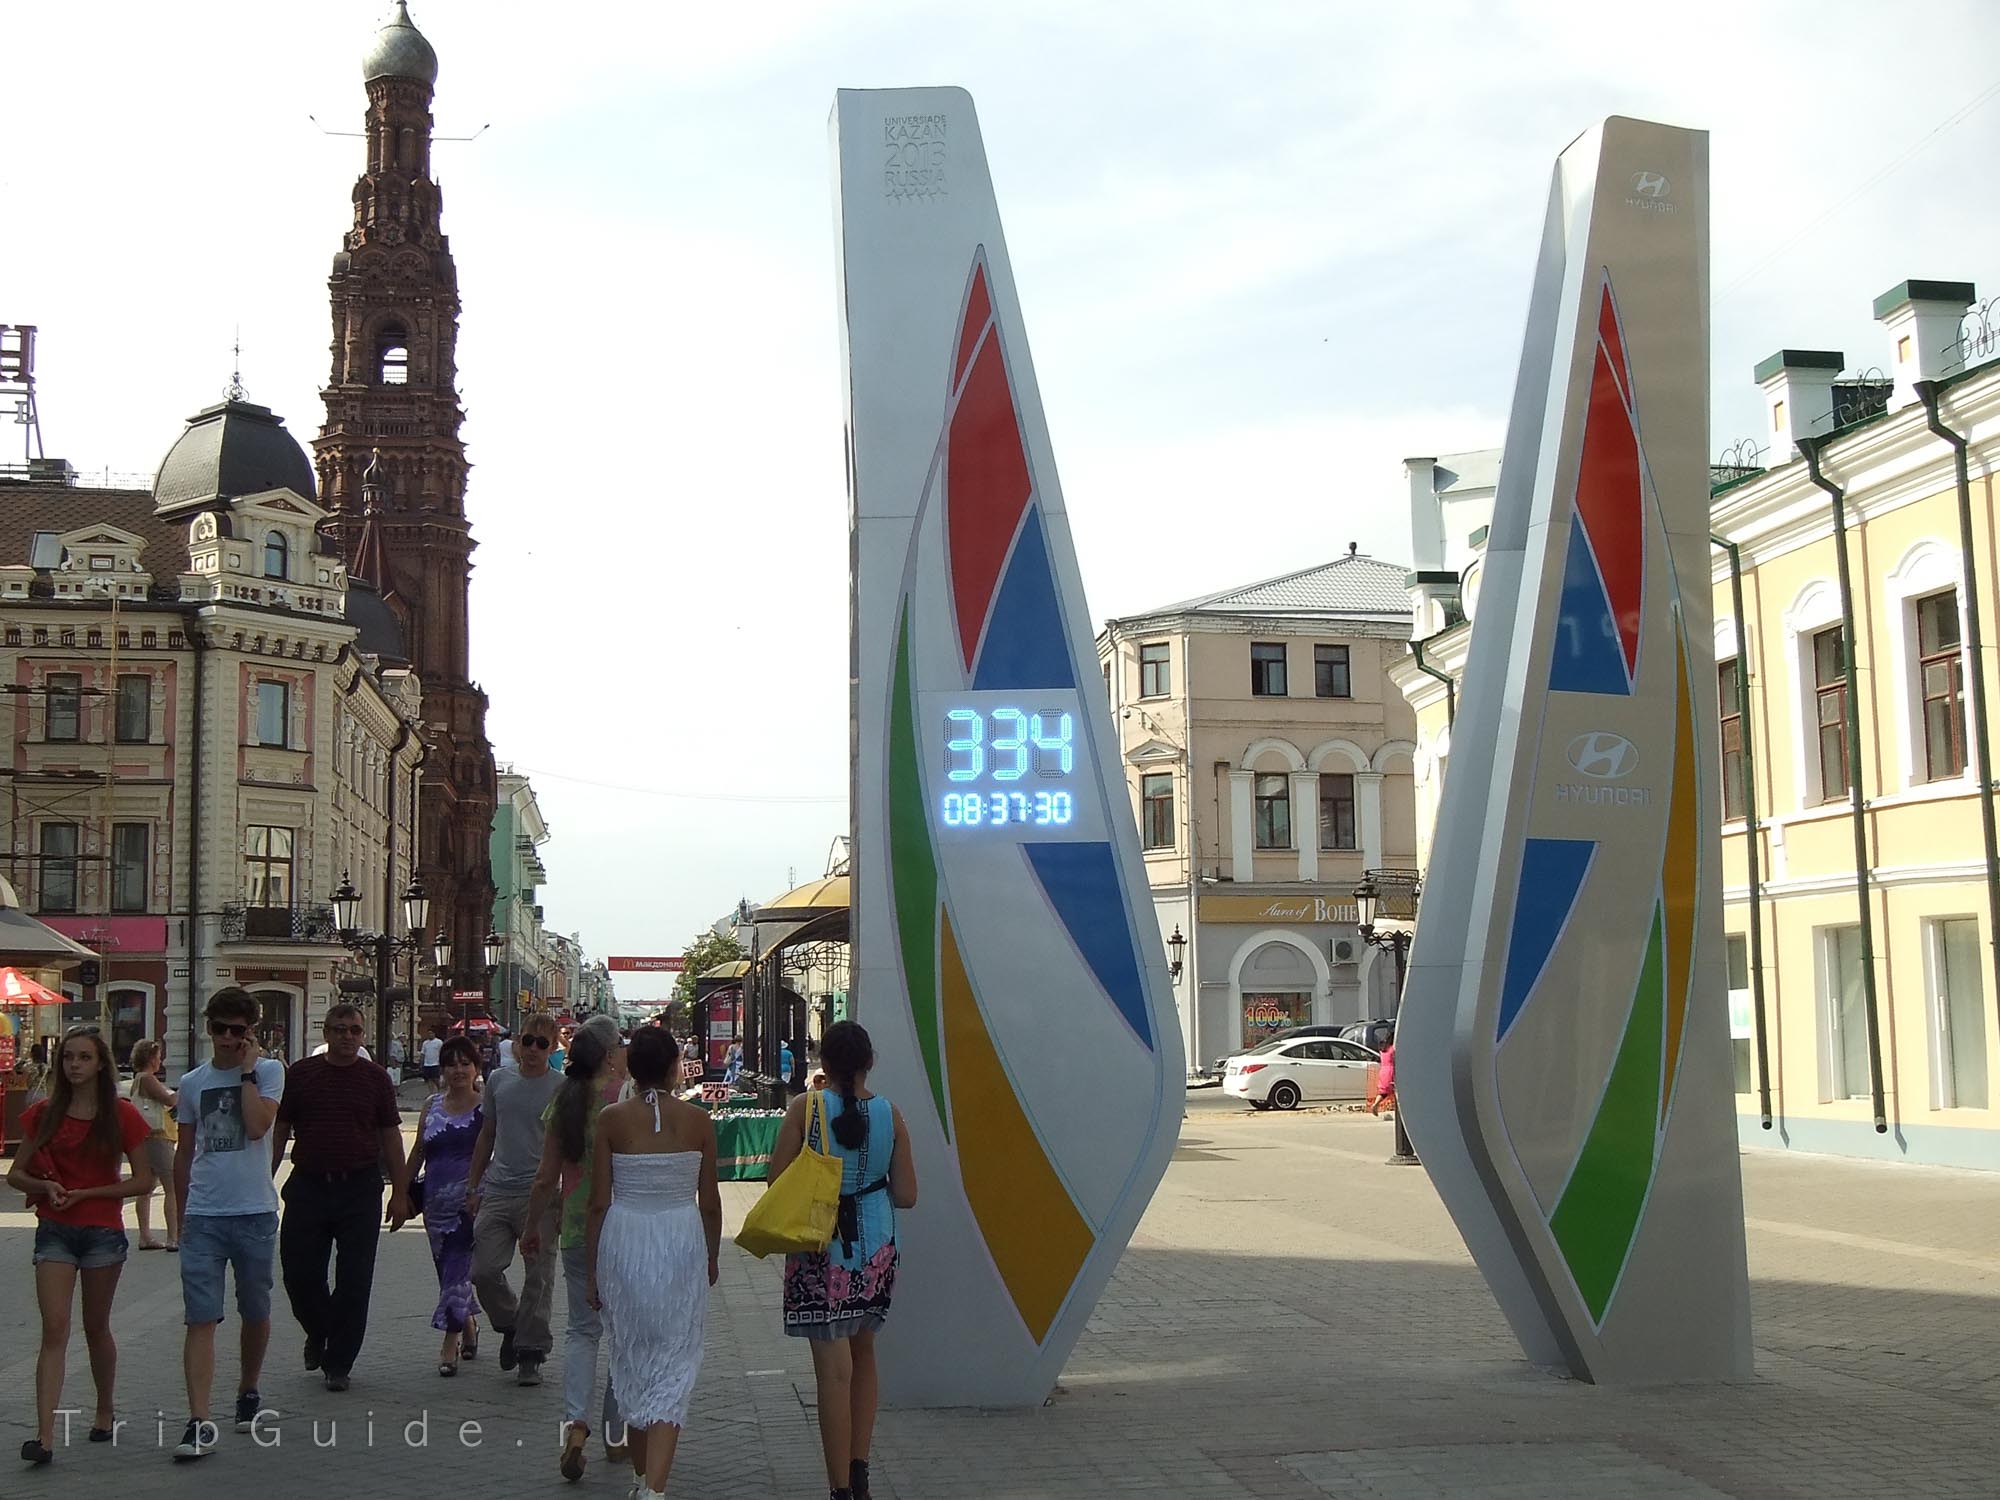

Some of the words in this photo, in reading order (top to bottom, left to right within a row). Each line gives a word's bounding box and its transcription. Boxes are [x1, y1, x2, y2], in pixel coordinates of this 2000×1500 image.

[884, 124, 946, 140] KAZAN
[884, 141, 946, 168] 2013
[946, 708, 1073, 781] 334
[1555, 783, 1651, 807] HYUNDAI
[943, 791, 1073, 826] 08:37:30
[1245, 1006, 1292, 1027] 100%
[683, 1066, 701, 1077] 150
[703, 1089, 726, 1099] 70
